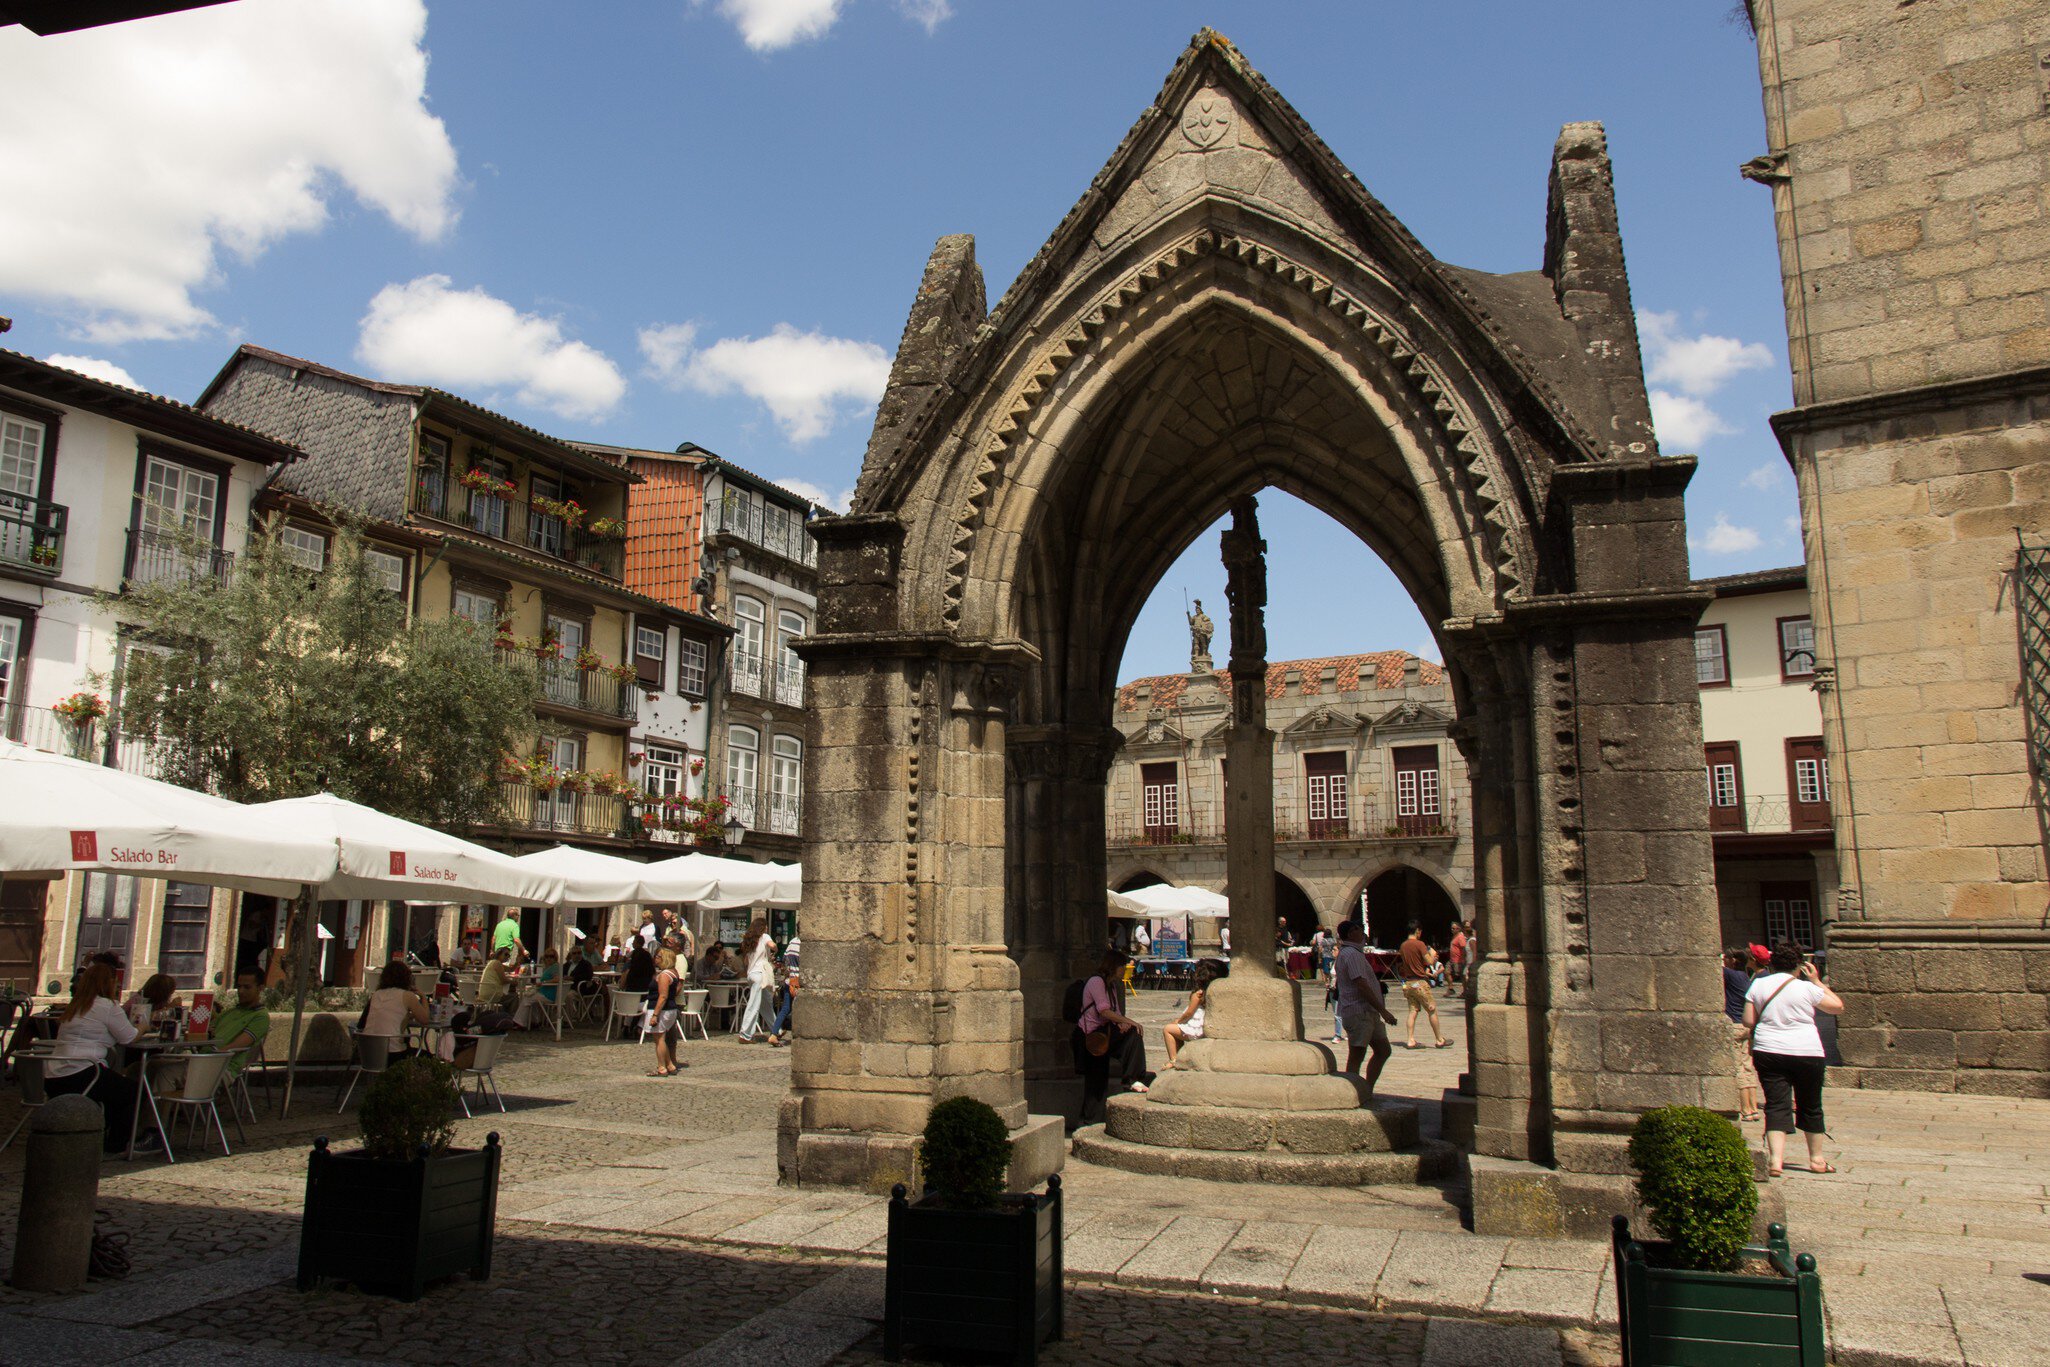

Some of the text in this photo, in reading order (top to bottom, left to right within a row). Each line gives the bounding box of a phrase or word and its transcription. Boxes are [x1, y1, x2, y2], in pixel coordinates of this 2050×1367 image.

[111, 847, 178, 863] Salado Bar
[414, 866, 457, 881] Salado Bar
